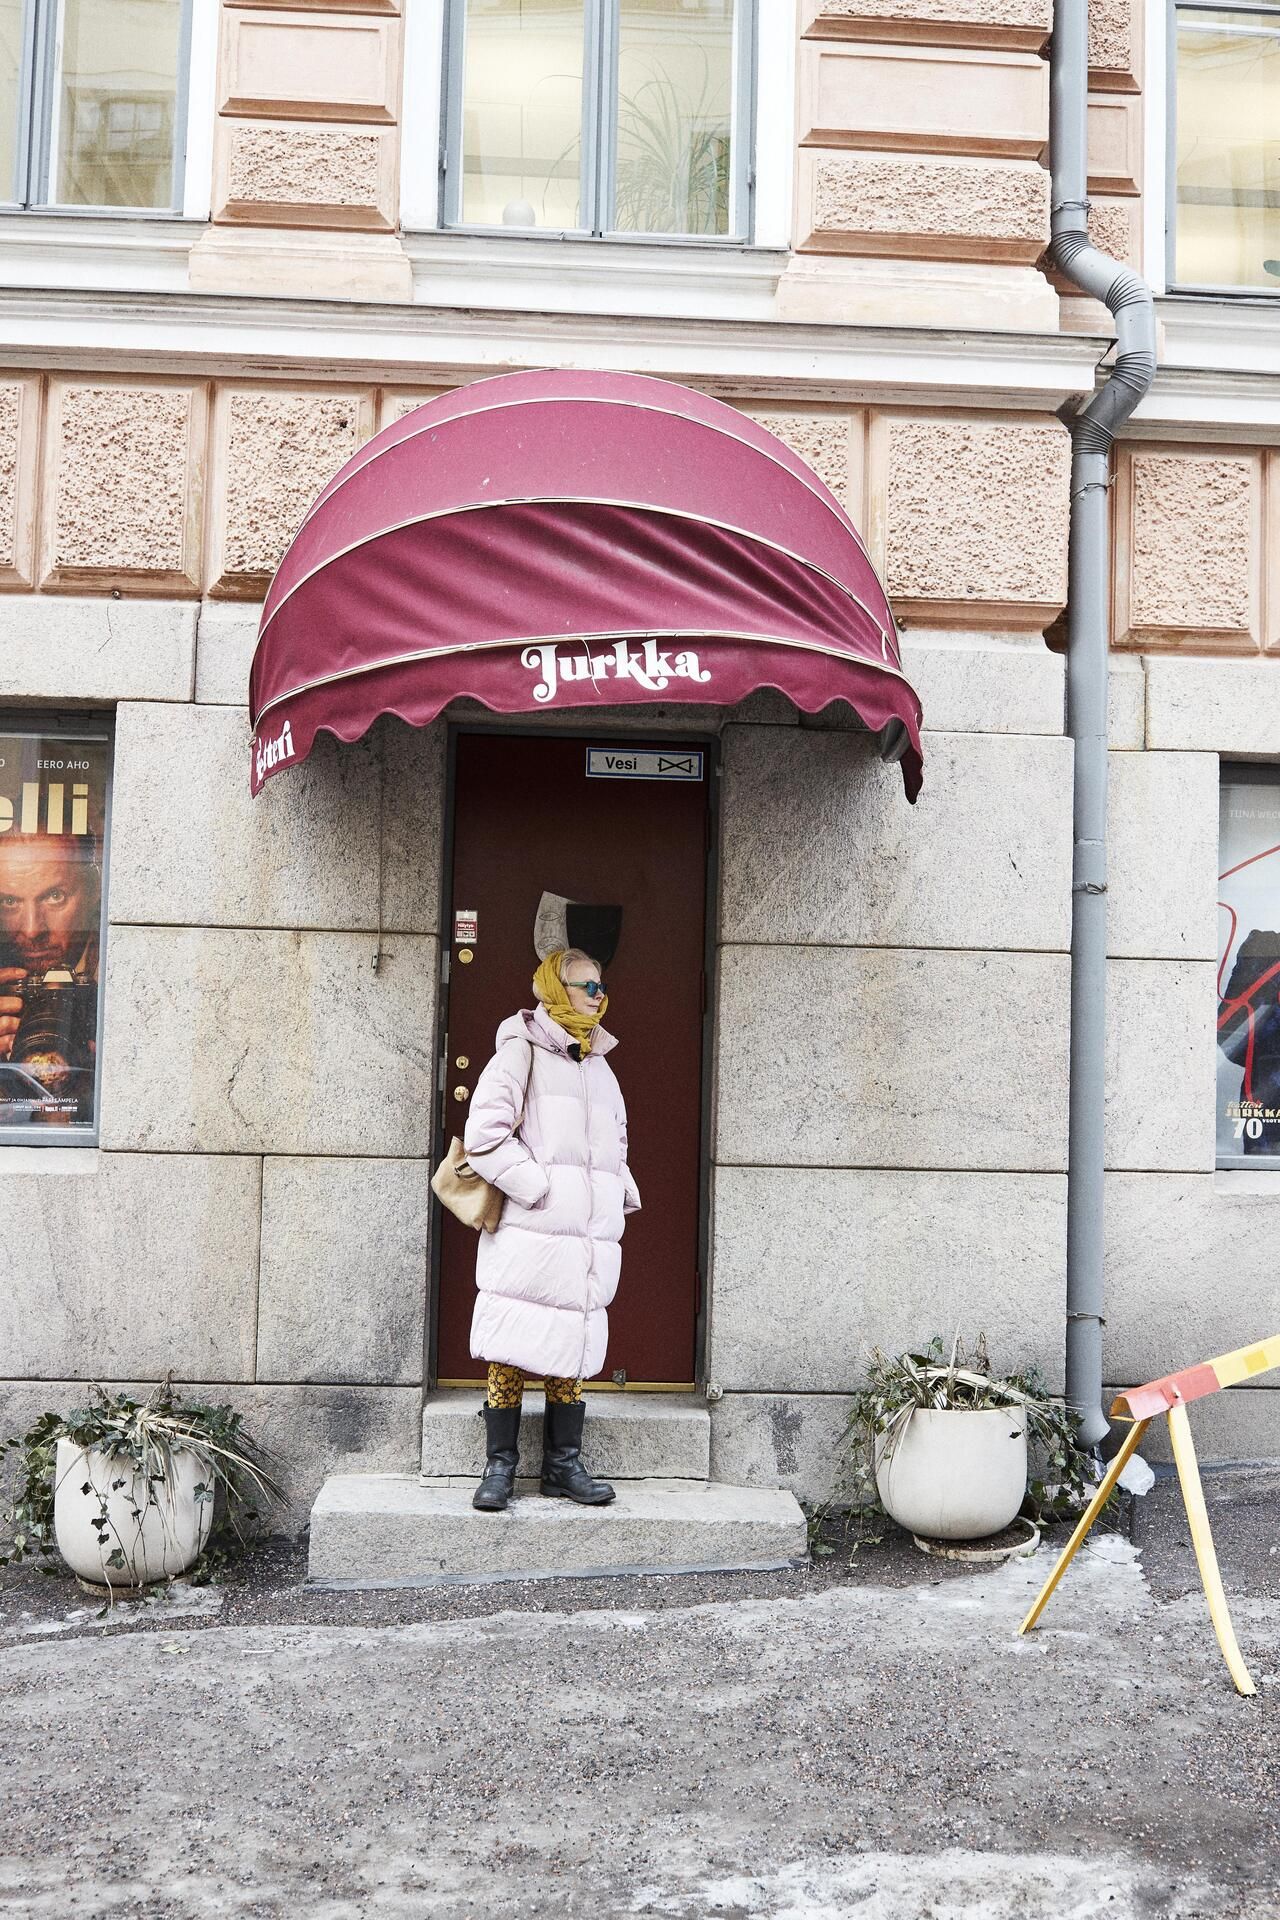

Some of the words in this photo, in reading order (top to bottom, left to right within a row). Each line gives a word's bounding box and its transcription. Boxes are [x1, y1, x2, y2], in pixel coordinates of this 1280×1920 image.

[521, 639, 711, 702] Jurkka
[37, 760, 63, 769] EERO
[67, 760, 89, 770] AHO
[605, 757, 637, 770] Vesi
[1231, 1118, 1263, 1139] 70
